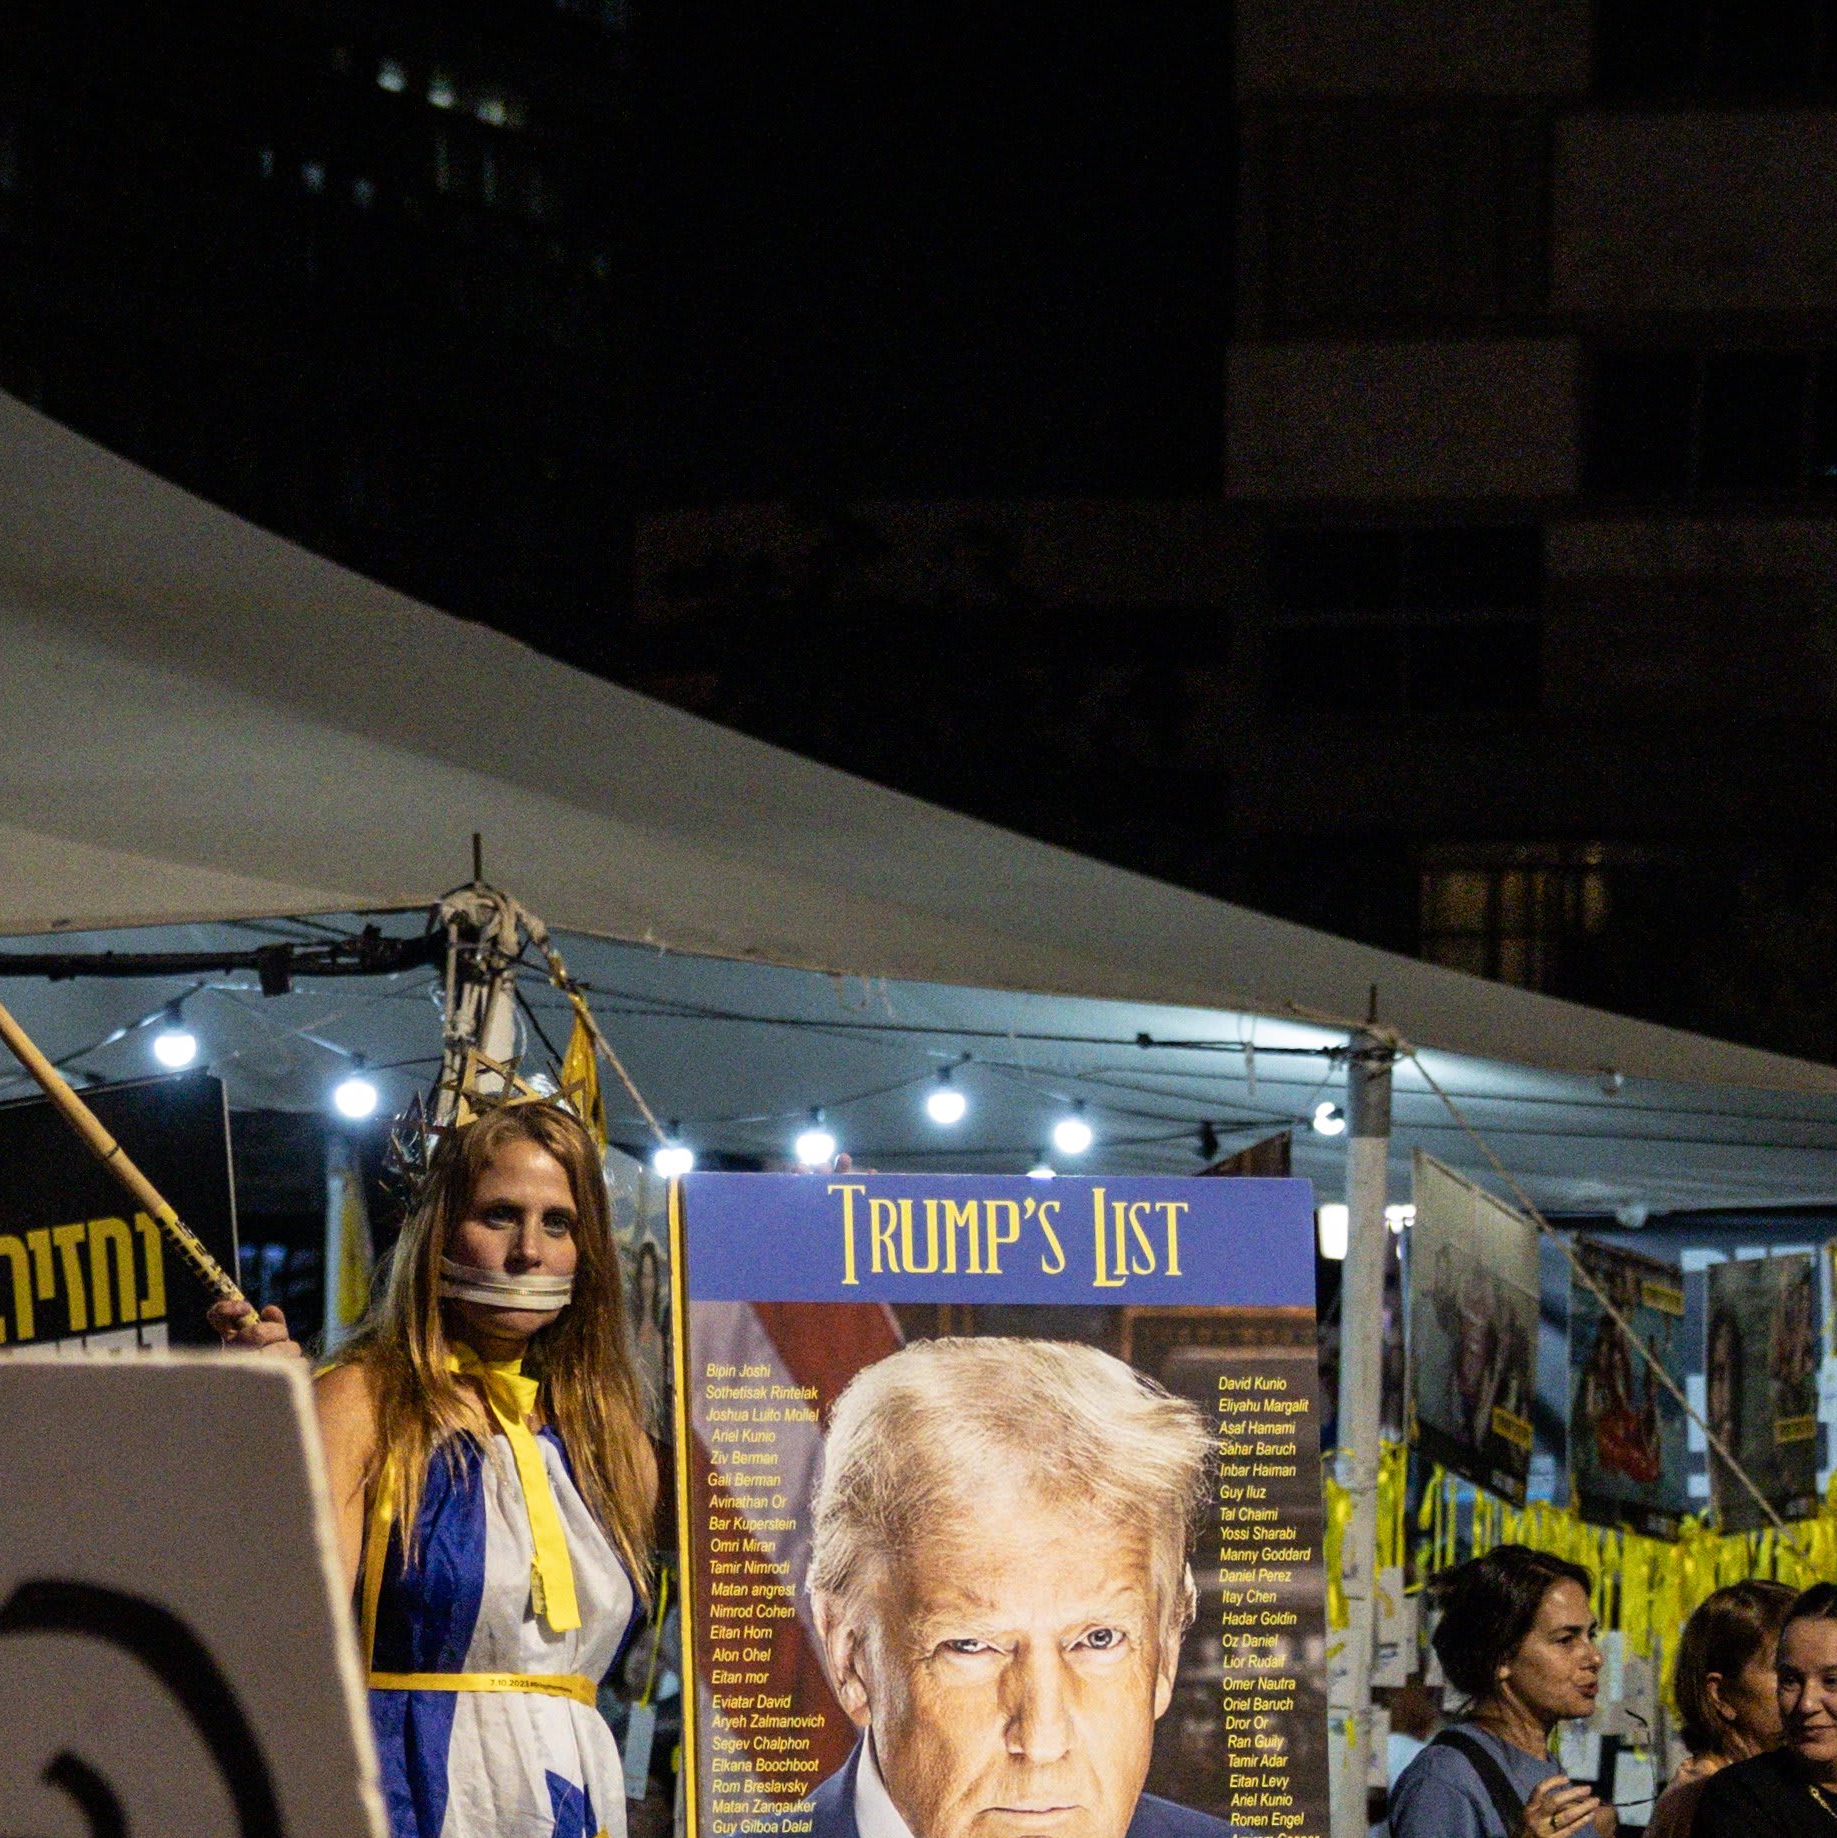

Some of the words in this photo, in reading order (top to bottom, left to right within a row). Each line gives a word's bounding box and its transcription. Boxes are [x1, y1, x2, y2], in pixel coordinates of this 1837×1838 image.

[827, 1185, 1066, 1285] TRUMP'S
[1092, 1188, 1189, 1287] LIST
[707, 1364, 735, 1379] Bipin
[739, 1364, 770, 1377] Joshi
[1219, 1377, 1250, 1390] David
[1255, 1377, 1286, 1390] Kunio
[770, 1386, 818, 1400] Rintelak
[1219, 1399, 1260, 1415] Eliyahu
[1264, 1400, 1308, 1415] Margalit
[706, 1408, 748, 1422] Joshua
[1219, 1421, 1246, 1434] Asaf
[1248, 1422, 1296, 1434] Hamami
[713, 1430, 738, 1442] Ariel
[1219, 1443, 1253, 1456] Sahar
[1256, 1443, 1296, 1455] Baruch
[711, 1451, 728, 1465] Ziv
[732, 1452, 778, 1465] Berman
[1220, 1464, 1249, 1477] Inbar
[1253, 1464, 1296, 1477] Haiman
[708, 1473, 731, 1486] Gali
[735, 1474, 780, 1486] Berman
[1220, 1486, 1243, 1501] Guy
[710, 1496, 768, 1508] Avinathan
[772, 1496, 786, 1508] Or
[1220, 1508, 1235, 1521] Tal
[1239, 1508, 1278, 1521] Chaimi
[709, 1517, 729, 1530] Bar
[734, 1518, 796, 1534] Kuperstein
[1220, 1528, 1249, 1540] Yossi
[1253, 1527, 1296, 1540] Sharabi
[711, 1539, 739, 1552] Omri
[743, 1539, 775, 1552] Miran
[1220, 1548, 1258, 1563] Manny
[1262, 1548, 1311, 1561] Goddard
[710, 1561, 739, 1574] Tamir
[745, 1562, 790, 1574] Nimrodi
[1220, 1569, 1255, 1582] Daniel
[1259, 1569, 1291, 1582] Perez
[712, 1583, 748, 1596] Matan
[1223, 1591, 1242, 1606] Itay
[1246, 1591, 1276, 1603] Chen
[710, 1604, 752, 1617] Nimrod
[757, 1605, 795, 1618] Cohen
[1222, 1613, 1257, 1625] Hadar
[1261, 1613, 1296, 1625] Goldin
[710, 1627, 740, 1639] Eitan
[1223, 1635, 1237, 1647] Oz
[1242, 1635, 1278, 1647] Daniel
[712, 1649, 738, 1661] Alon
[743, 1649, 771, 1661] Ohel
[1224, 1656, 1244, 1668] Lior
[712, 1671, 741, 1684] Eitan
[745, 1673, 769, 1684] mor
[1223, 1677, 1254, 1690] Omer
[1258, 1678, 1295, 1690] Nautra
[713, 1696, 754, 1708] Eviatar
[757, 1696, 791, 1708] David
[1253, 1698, 1293, 1710] Baruch
[712, 1715, 746, 1731] Aryeh
[750, 1715, 825, 1728] Zalmanovich
[1226, 1717, 1251, 1730] Dror
[1254, 1717, 1268, 1730] Or
[713, 1737, 749, 1751] Segev
[754, 1738, 809, 1753] Chalphon
[1228, 1736, 1251, 1748] Ran
[1229, 1755, 1258, 1767] Tamir
[1260, 1755, 1288, 1767] Adar
[713, 1781, 740, 1793] Rom
[744, 1781, 808, 1796] Breslavsky
[1230, 1776, 1258, 1787] Eitan
[1262, 1776, 1289, 1790] Levy
[1231, 1794, 1257, 1806] Ariel
[1260, 1794, 1293, 1806] Kunio
[713, 1801, 748, 1813] Matan
[752, 1801, 816, 1816] Zangauker
[1231, 1813, 1267, 1825] Ronen
[1272, 1813, 1304, 1828] Engel
[713, 1820, 736, 1835] Guy
[741, 1820, 778, 1833] Gilboa
[782, 1820, 812, 1833] Dalal
